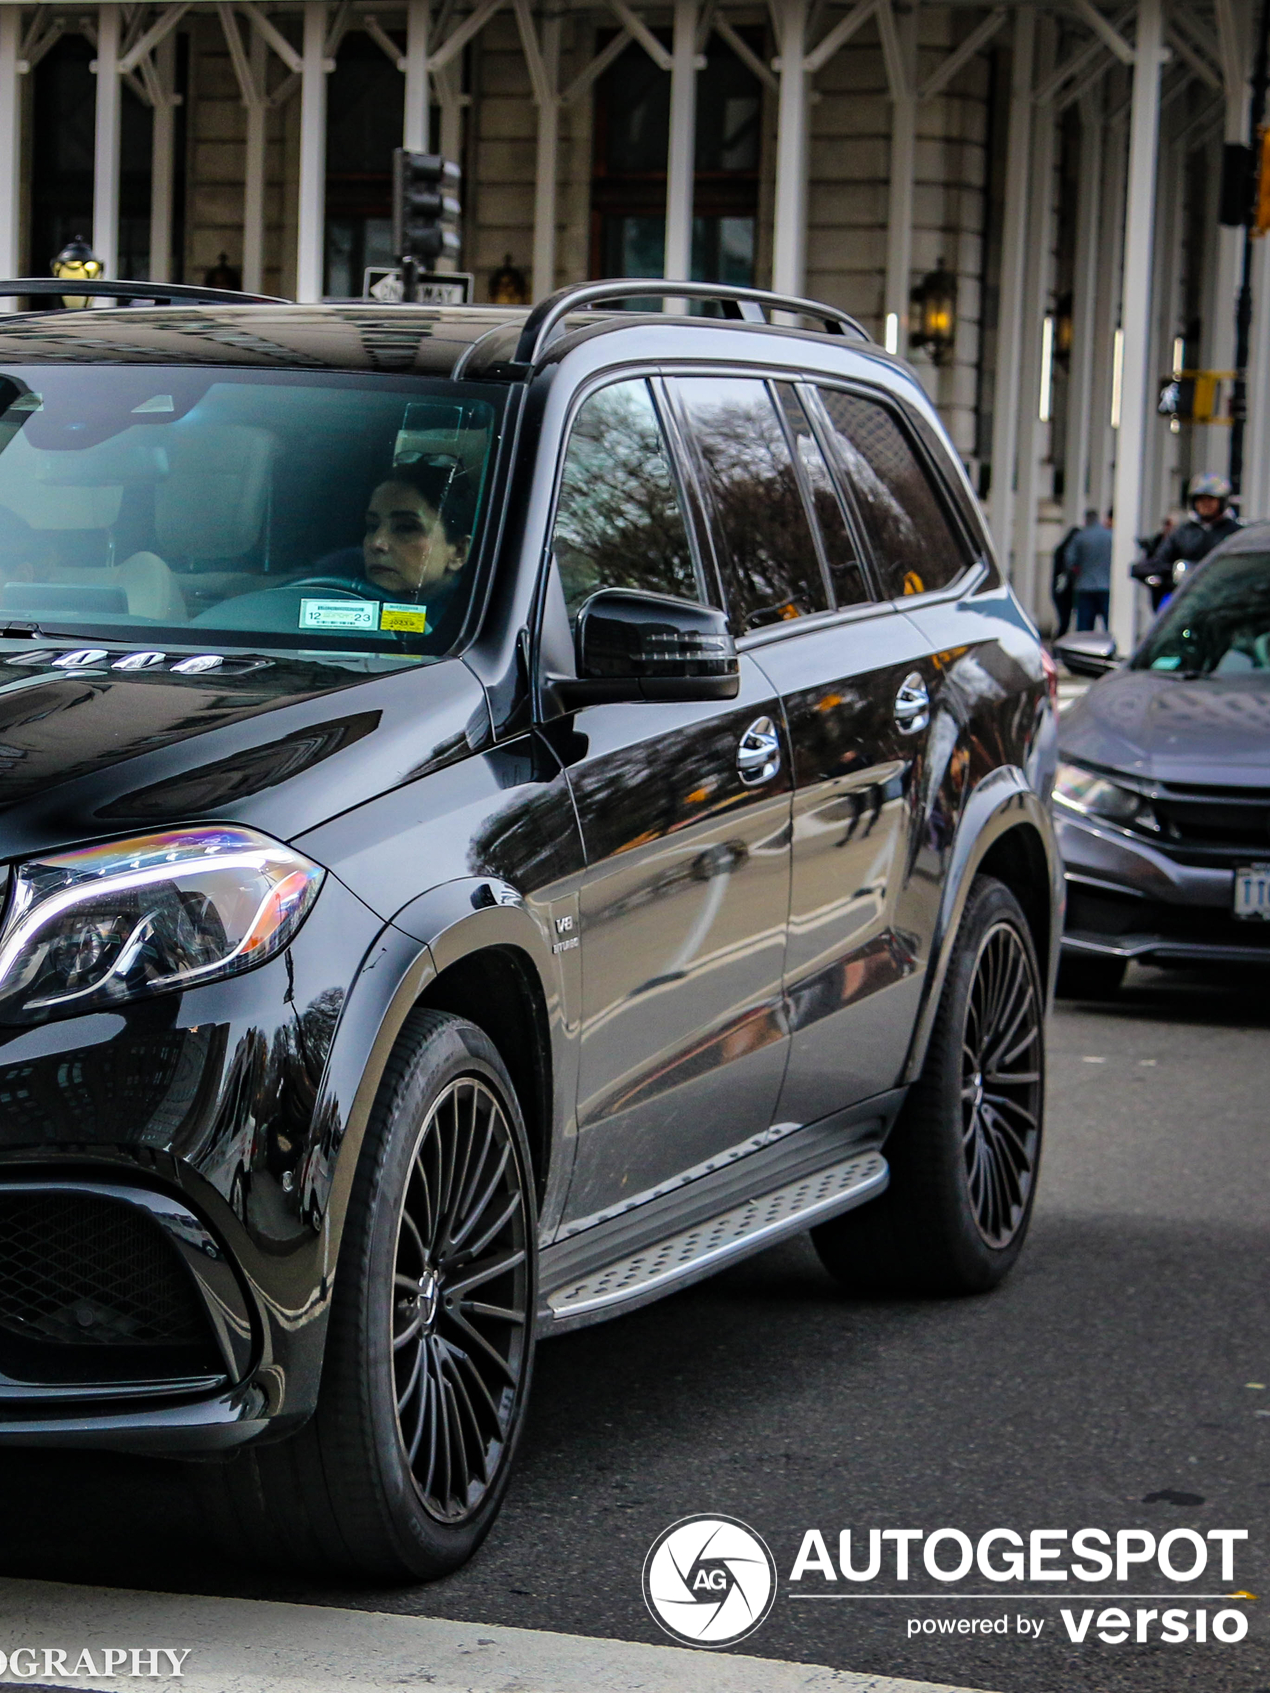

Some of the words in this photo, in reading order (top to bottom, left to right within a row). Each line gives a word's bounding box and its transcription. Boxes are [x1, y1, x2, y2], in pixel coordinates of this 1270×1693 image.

[422, 286, 454, 303] WAY
[309, 612, 322, 620] 12
[354, 613, 371, 622] 23
[555, 915, 573, 933] V8
